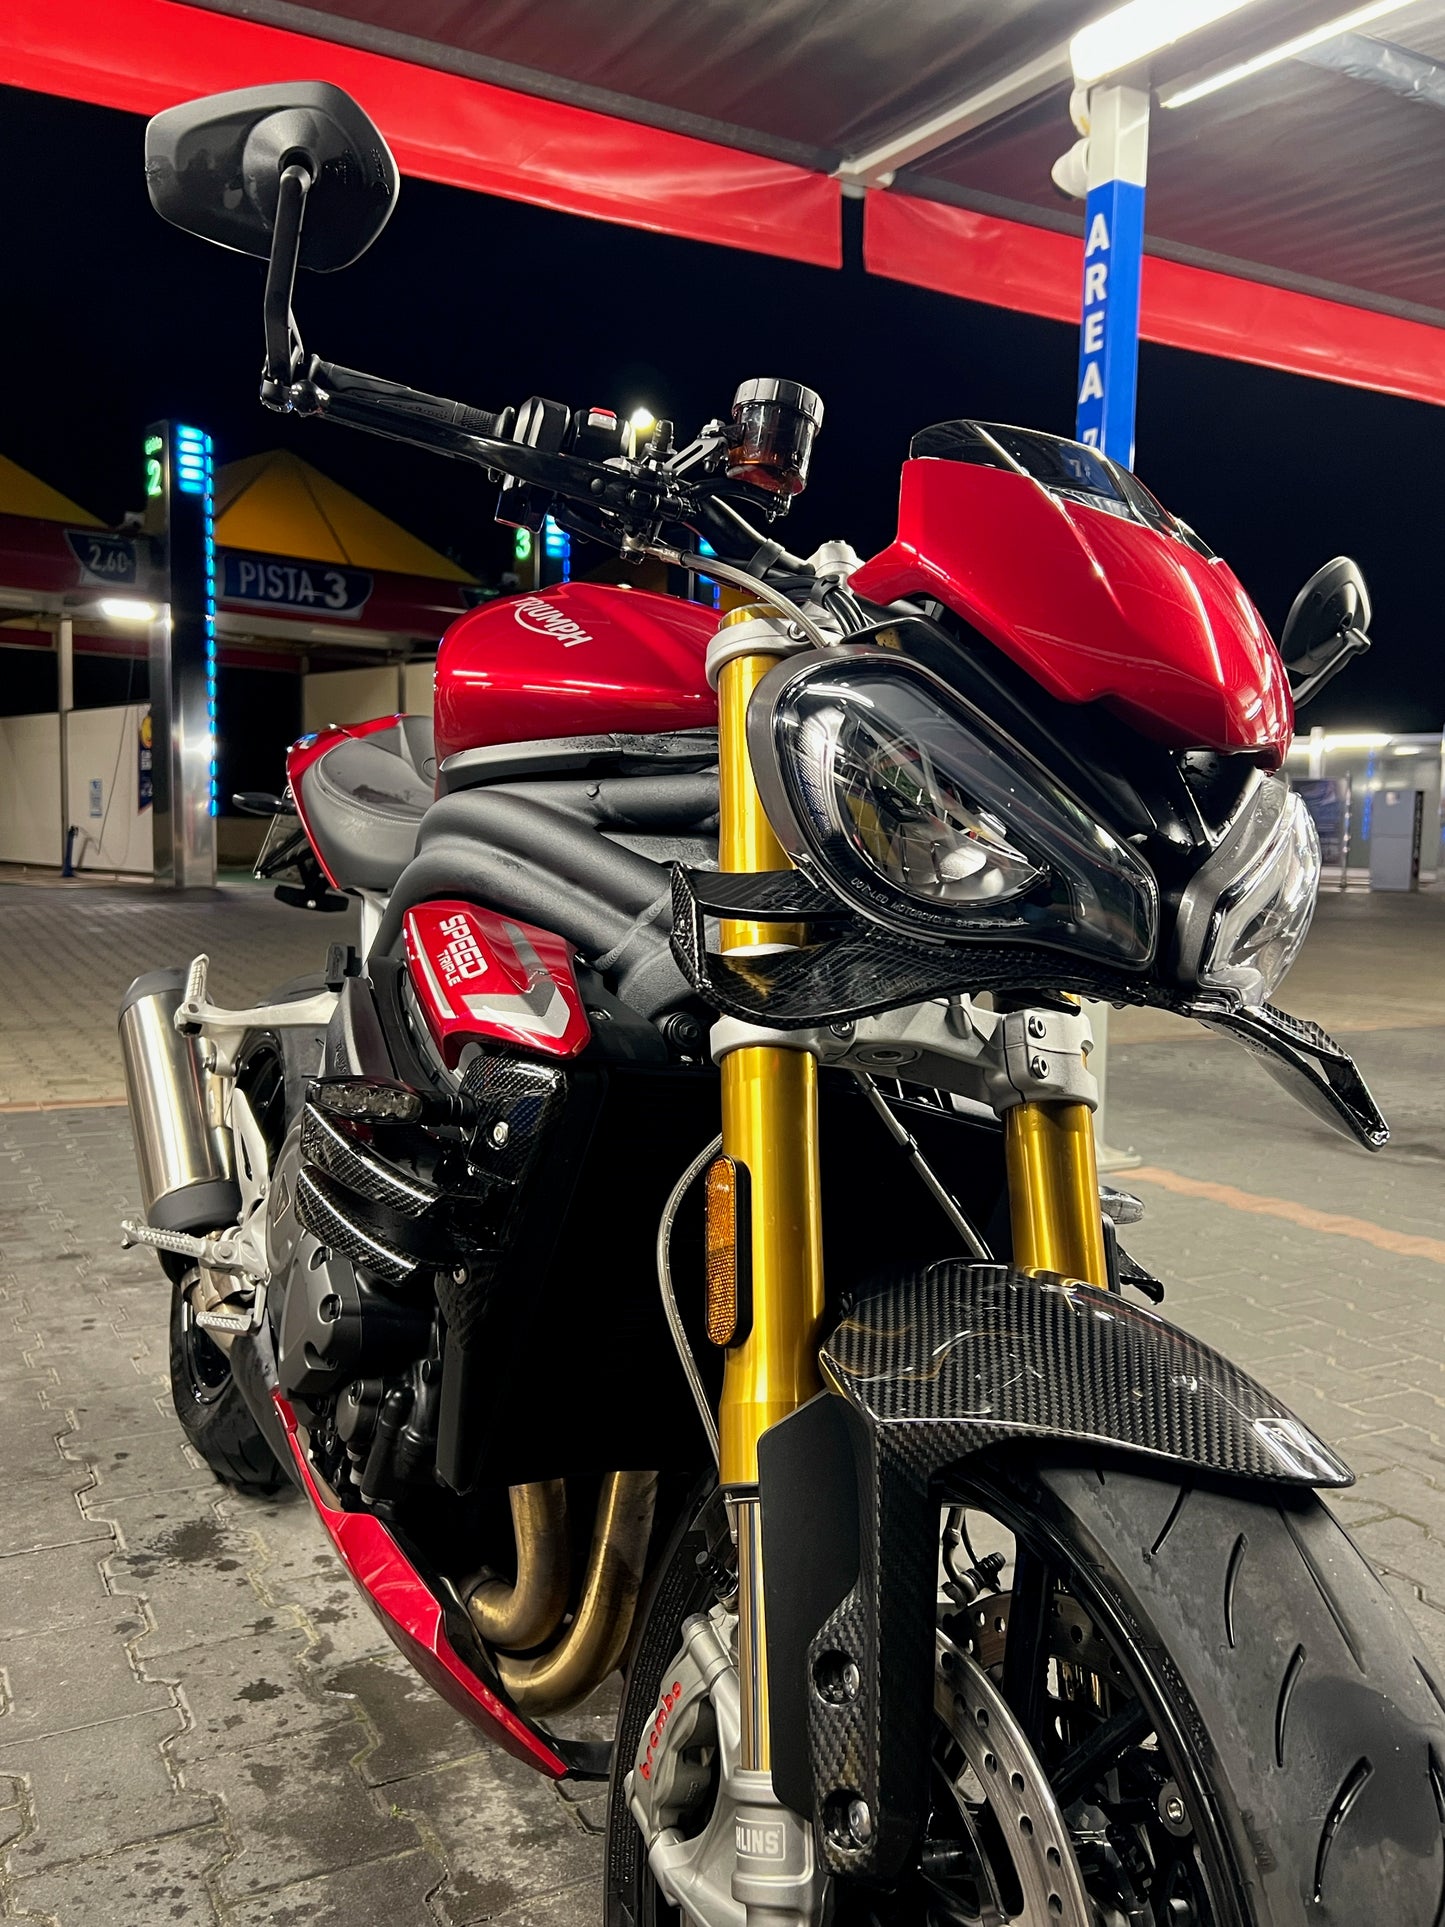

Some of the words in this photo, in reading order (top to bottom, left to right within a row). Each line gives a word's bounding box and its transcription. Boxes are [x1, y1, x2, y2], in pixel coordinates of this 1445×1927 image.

[1078, 213, 1110, 404] AREA
[147, 459, 162, 496] 2
[515, 527, 531, 559] 3
[239, 560, 315, 603] PISTA
[324, 571, 348, 608] 3
[510, 596, 593, 648] TRIUMPH
[890, 901, 950, 926] MOTORCYCLE
[436, 949, 462, 987] TRIPLE
[439, 914, 488, 979] SPEED
[639, 1681, 682, 1780] brembo
[736, 1825, 779, 1854] HLINS
